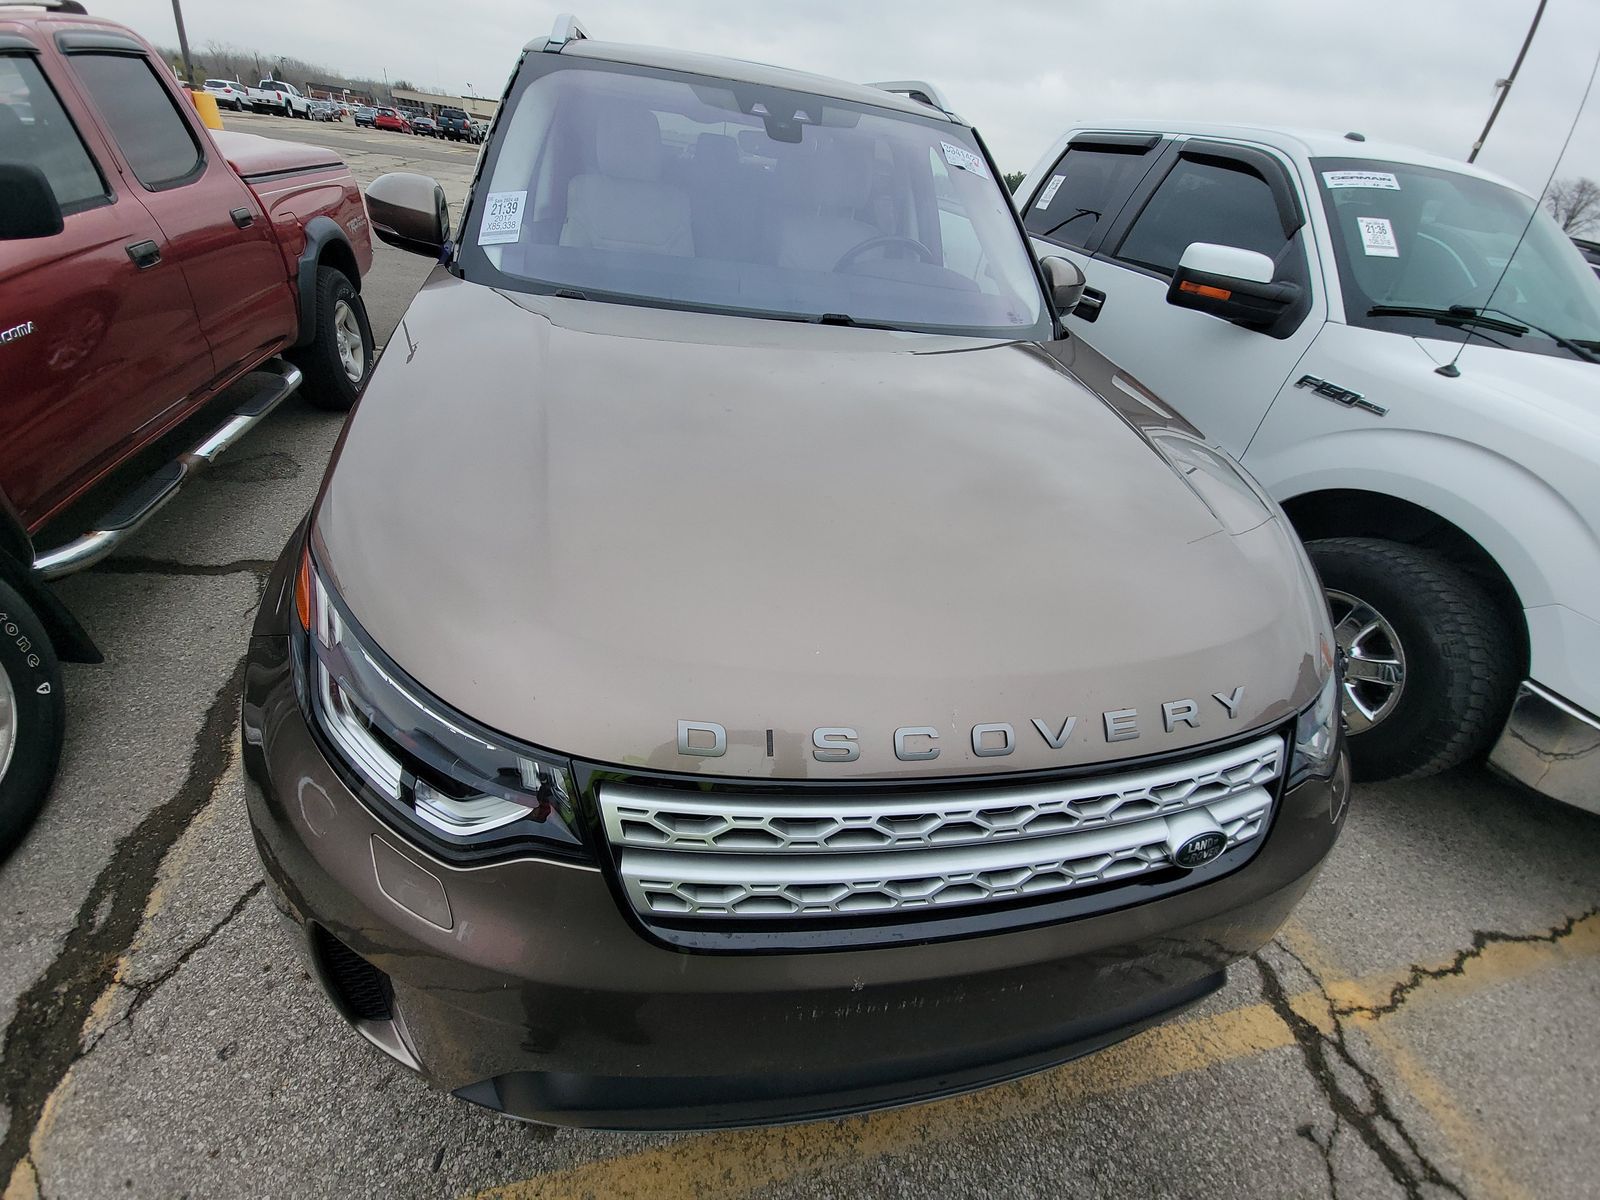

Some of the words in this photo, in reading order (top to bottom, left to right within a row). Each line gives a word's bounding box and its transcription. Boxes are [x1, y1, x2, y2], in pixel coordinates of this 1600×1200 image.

[491, 202, 518, 215] 21:39
[494, 214, 513, 222] 2017
[1365, 224, 1387, 235] 21:36
[677, 686, 1246, 763] DISCOVERY
[1188, 838, 1214, 852] LAND
[1188, 847, 1220, 862] ROVER
